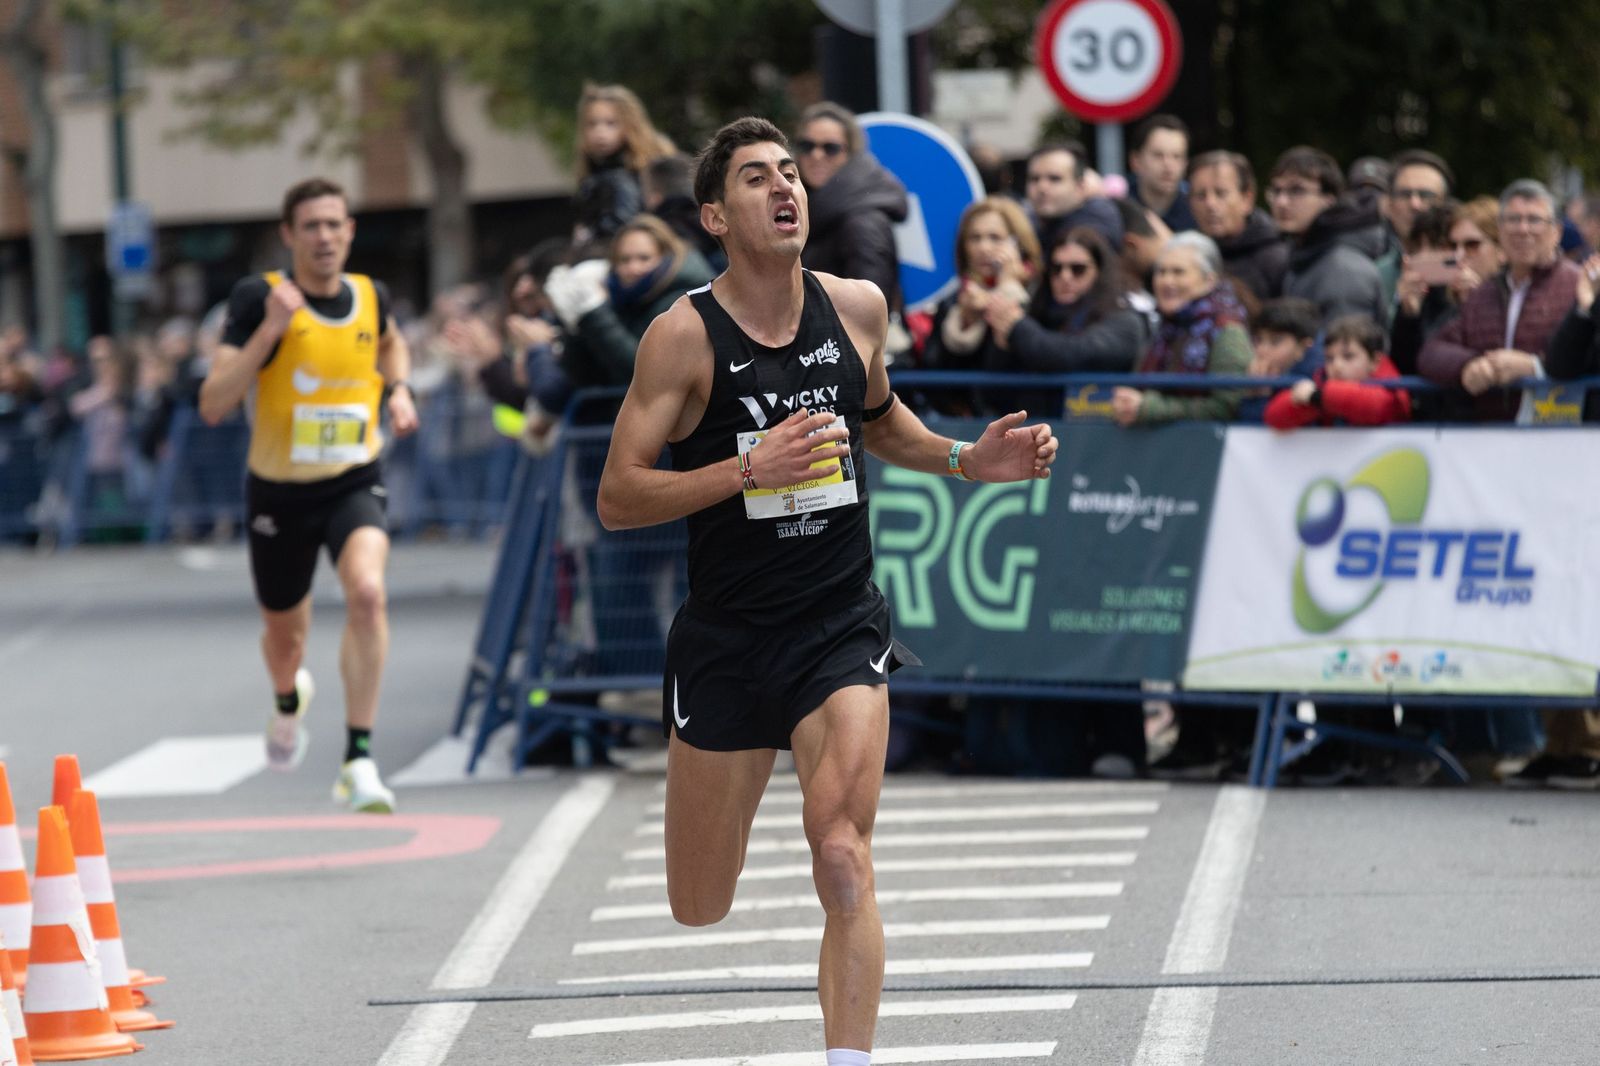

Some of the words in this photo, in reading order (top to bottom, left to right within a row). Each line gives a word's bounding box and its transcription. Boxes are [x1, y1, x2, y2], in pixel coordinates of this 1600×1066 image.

[1070, 28, 1145, 73] 30
[782, 385, 839, 411] VICKY
[787, 480, 819, 492] VICIOSA
[797, 494, 826, 504] Ayuntamiento
[777, 527, 798, 538] ISAAC
[1336, 529, 1536, 580] SETEL
[1456, 578, 1533, 607] Grupo
